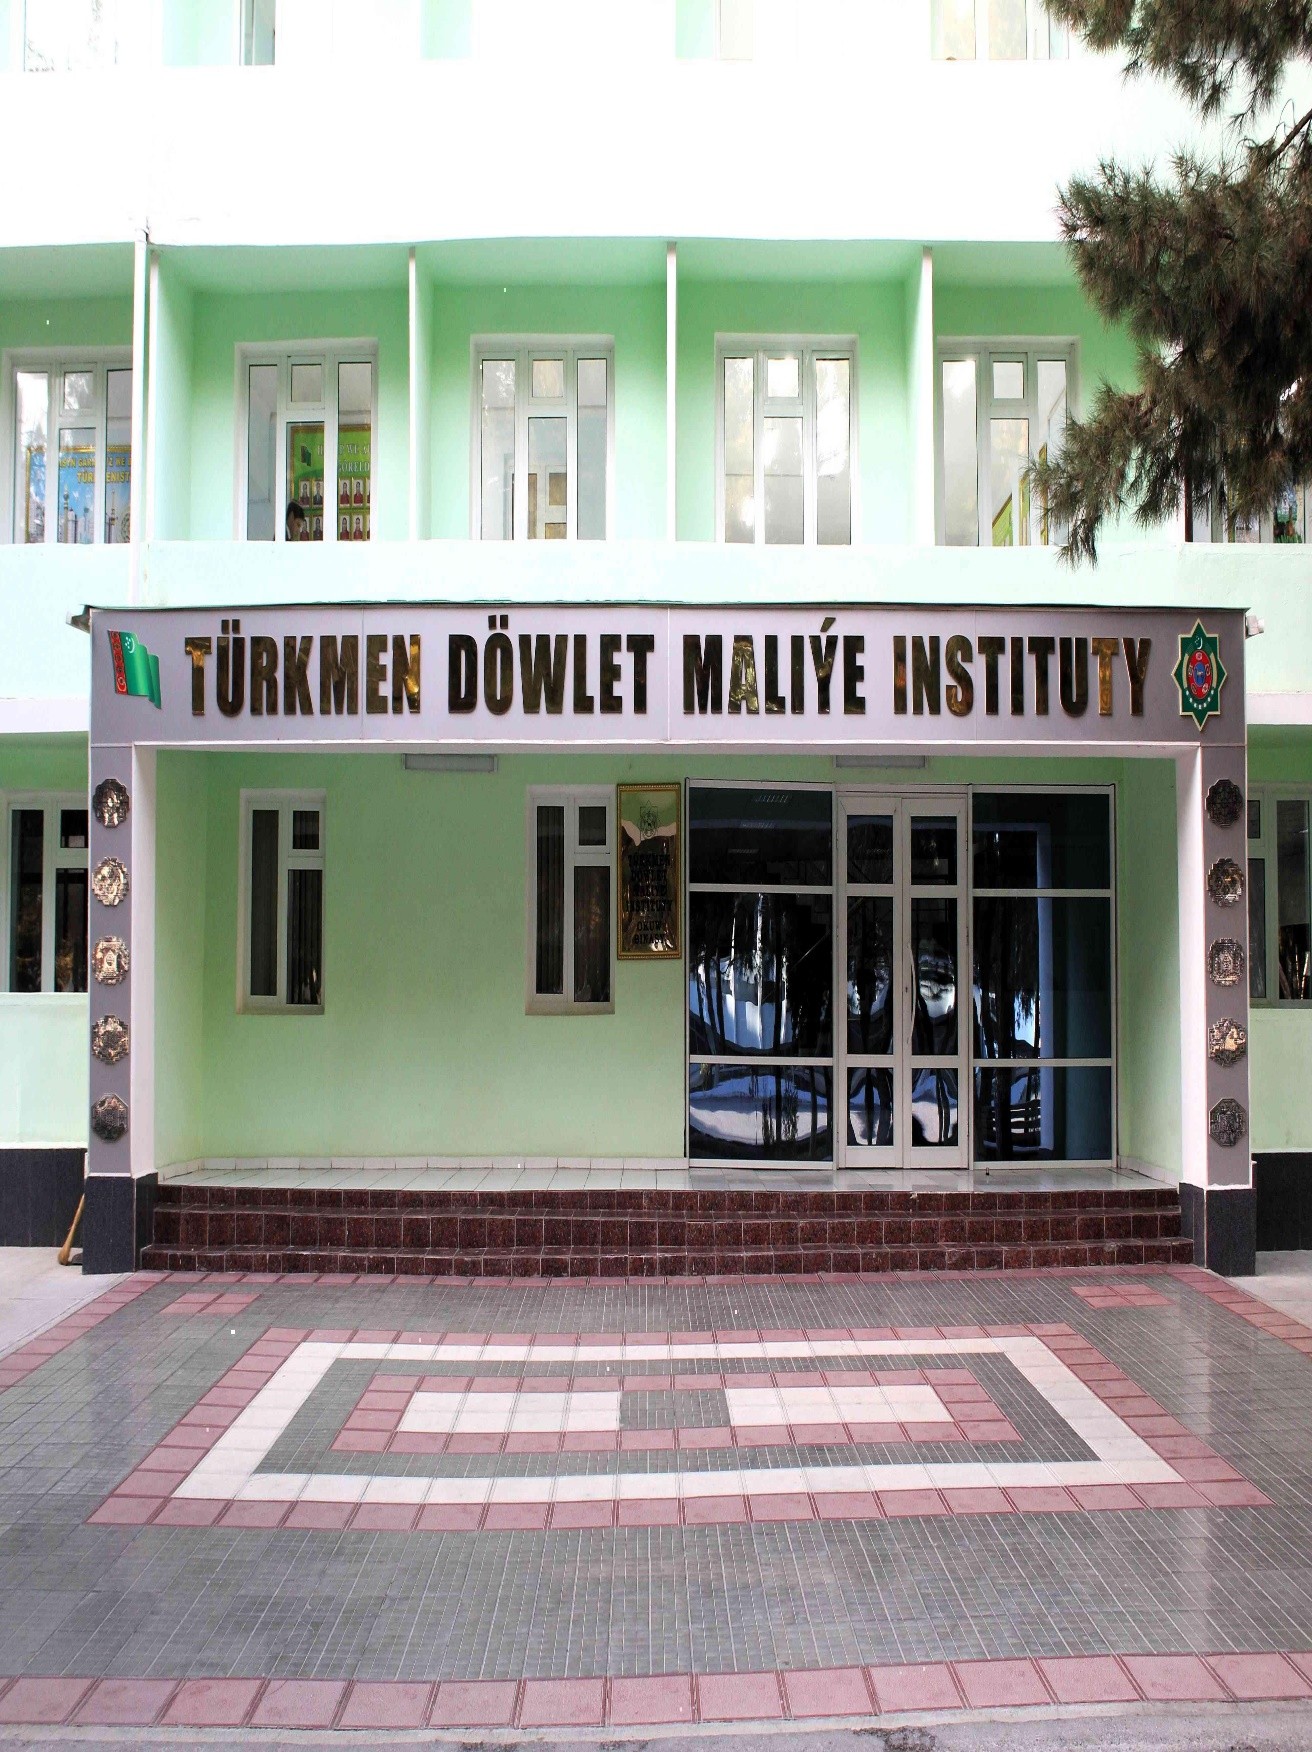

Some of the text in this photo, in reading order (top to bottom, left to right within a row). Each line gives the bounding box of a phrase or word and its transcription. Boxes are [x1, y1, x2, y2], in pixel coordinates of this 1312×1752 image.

[77, 470, 130, 482] TÜRENIST
[183, 614, 1152, 716] TÜRKMEN DÖWLET MALIÝE INSTITUTY
